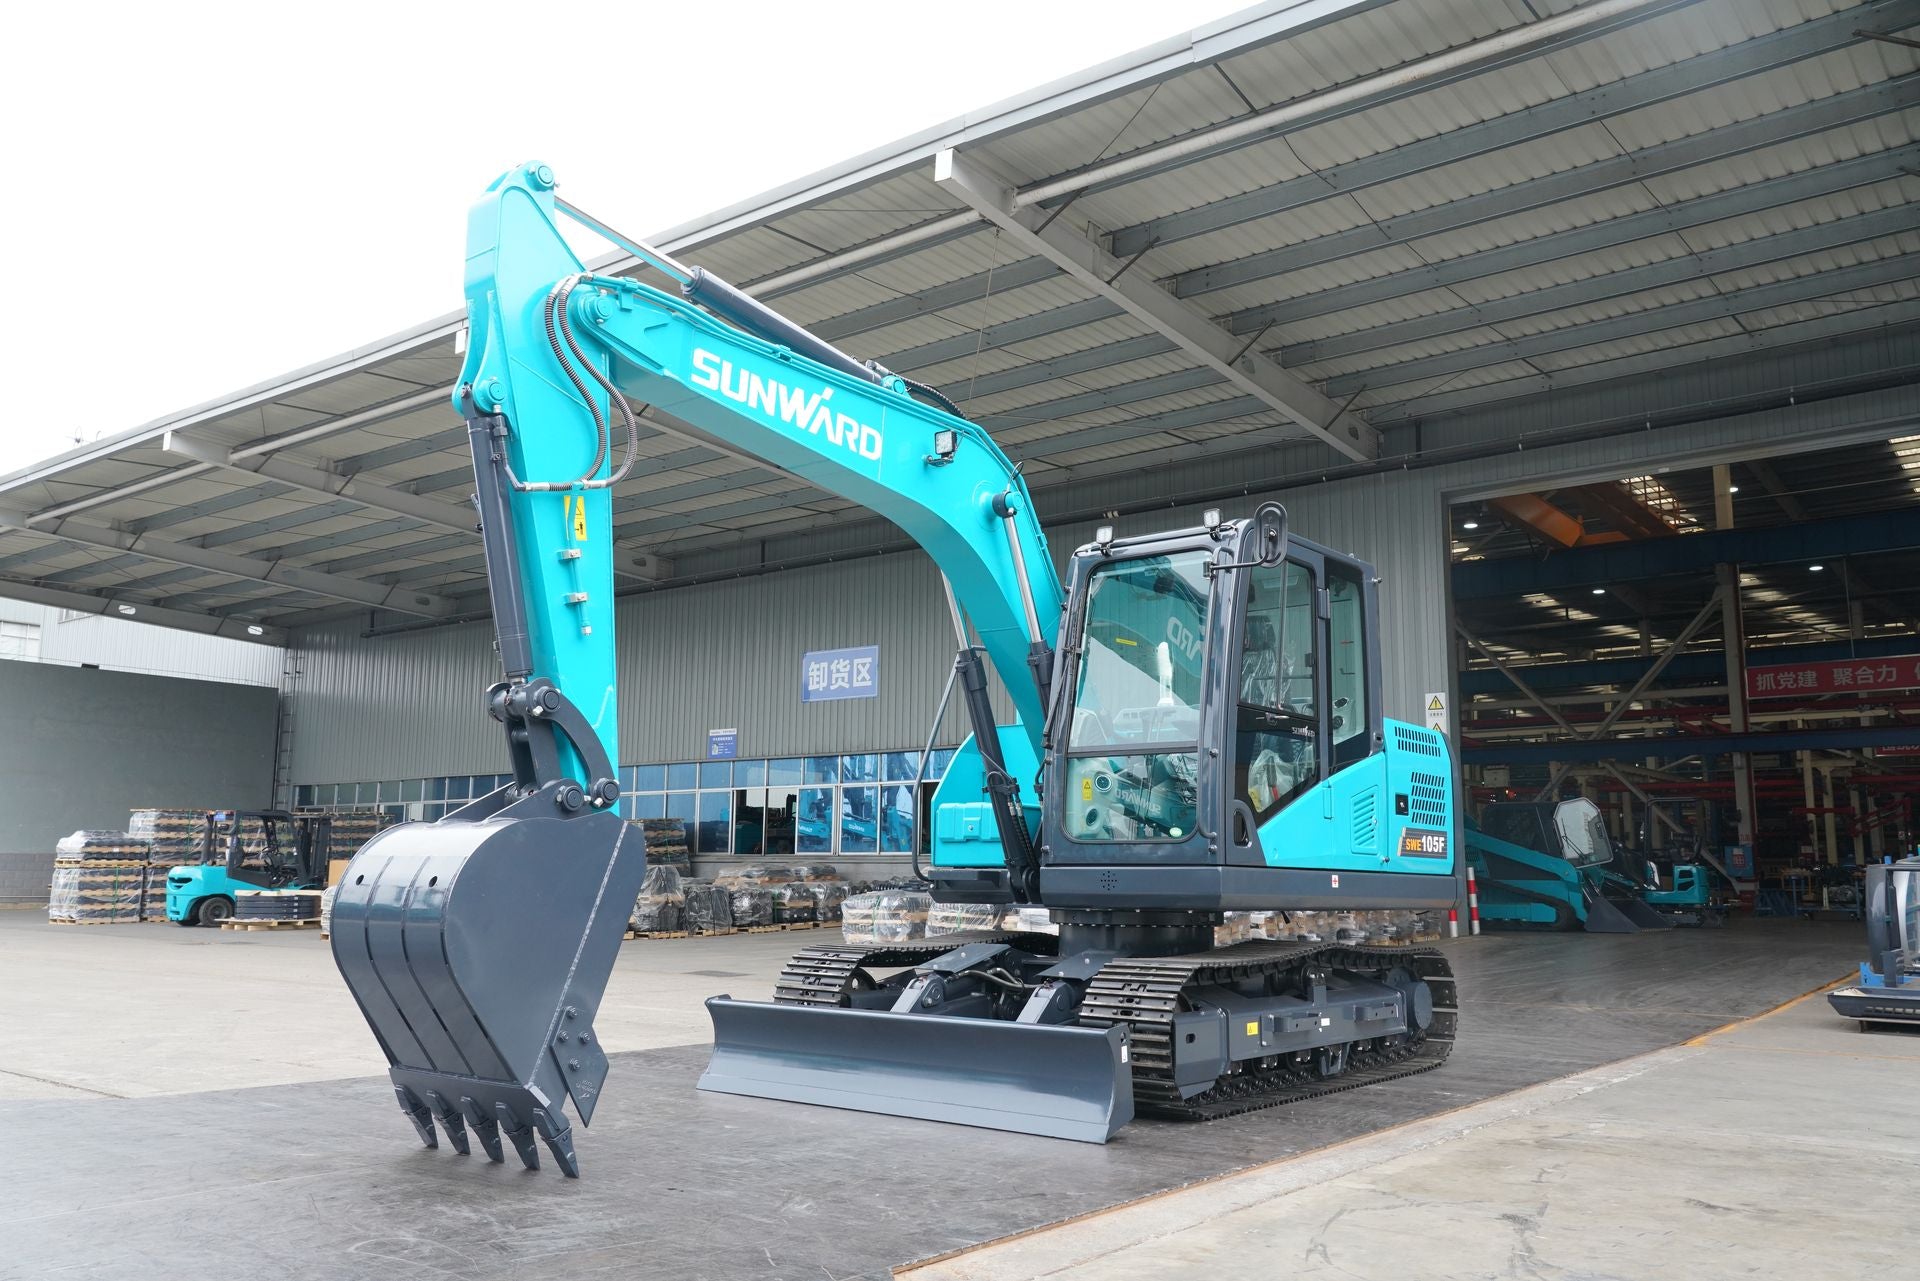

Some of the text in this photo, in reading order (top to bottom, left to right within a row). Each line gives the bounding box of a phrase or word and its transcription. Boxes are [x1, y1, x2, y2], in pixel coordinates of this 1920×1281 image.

[691, 347, 882, 461] SUNWARD
[807, 657, 872, 692] 卸货区
[1756, 670, 1818, 691] 抓党建
[1832, 664, 1897, 686] 聚合力
[1405, 835, 1445, 853] SWE105F
